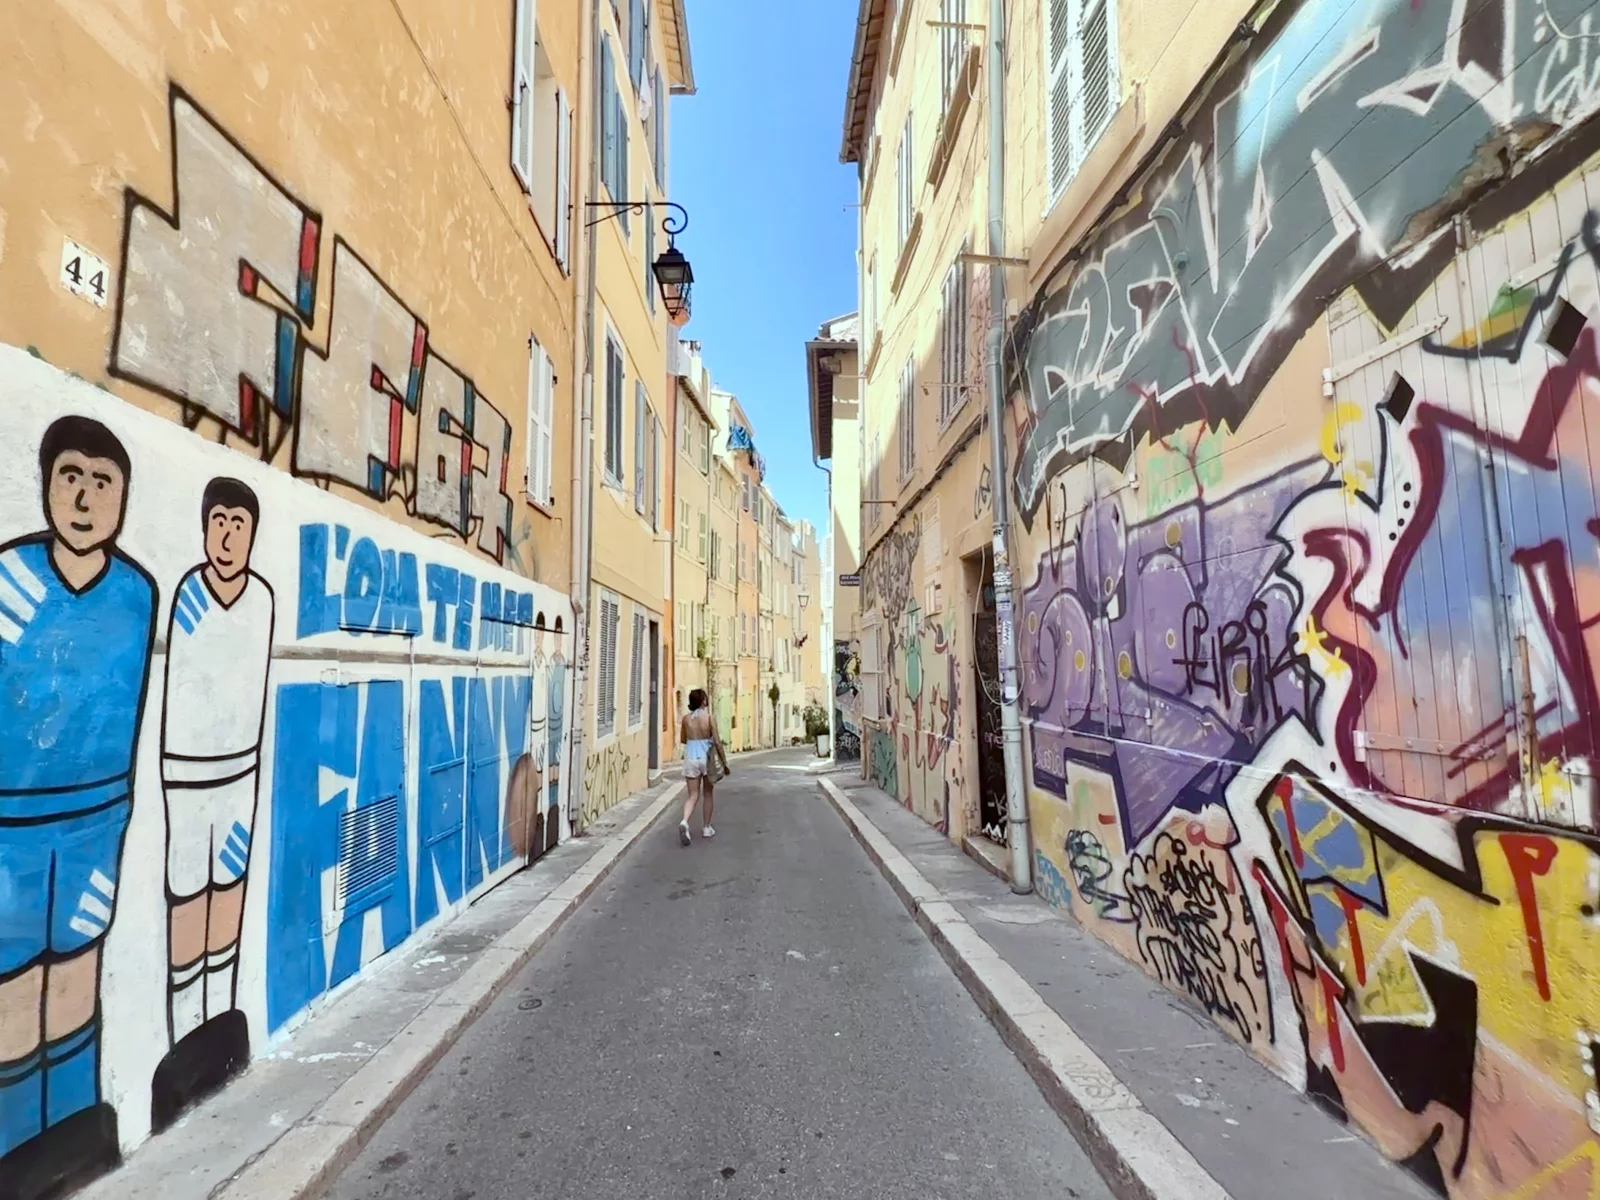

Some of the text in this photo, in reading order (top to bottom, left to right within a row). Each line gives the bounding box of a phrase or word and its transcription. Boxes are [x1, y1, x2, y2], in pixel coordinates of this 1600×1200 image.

[65, 256, 105, 299] 44
[297, 523, 423, 640] L'OM
[426, 563, 476, 651] TE
[266, 676, 532, 1037] FANNY
